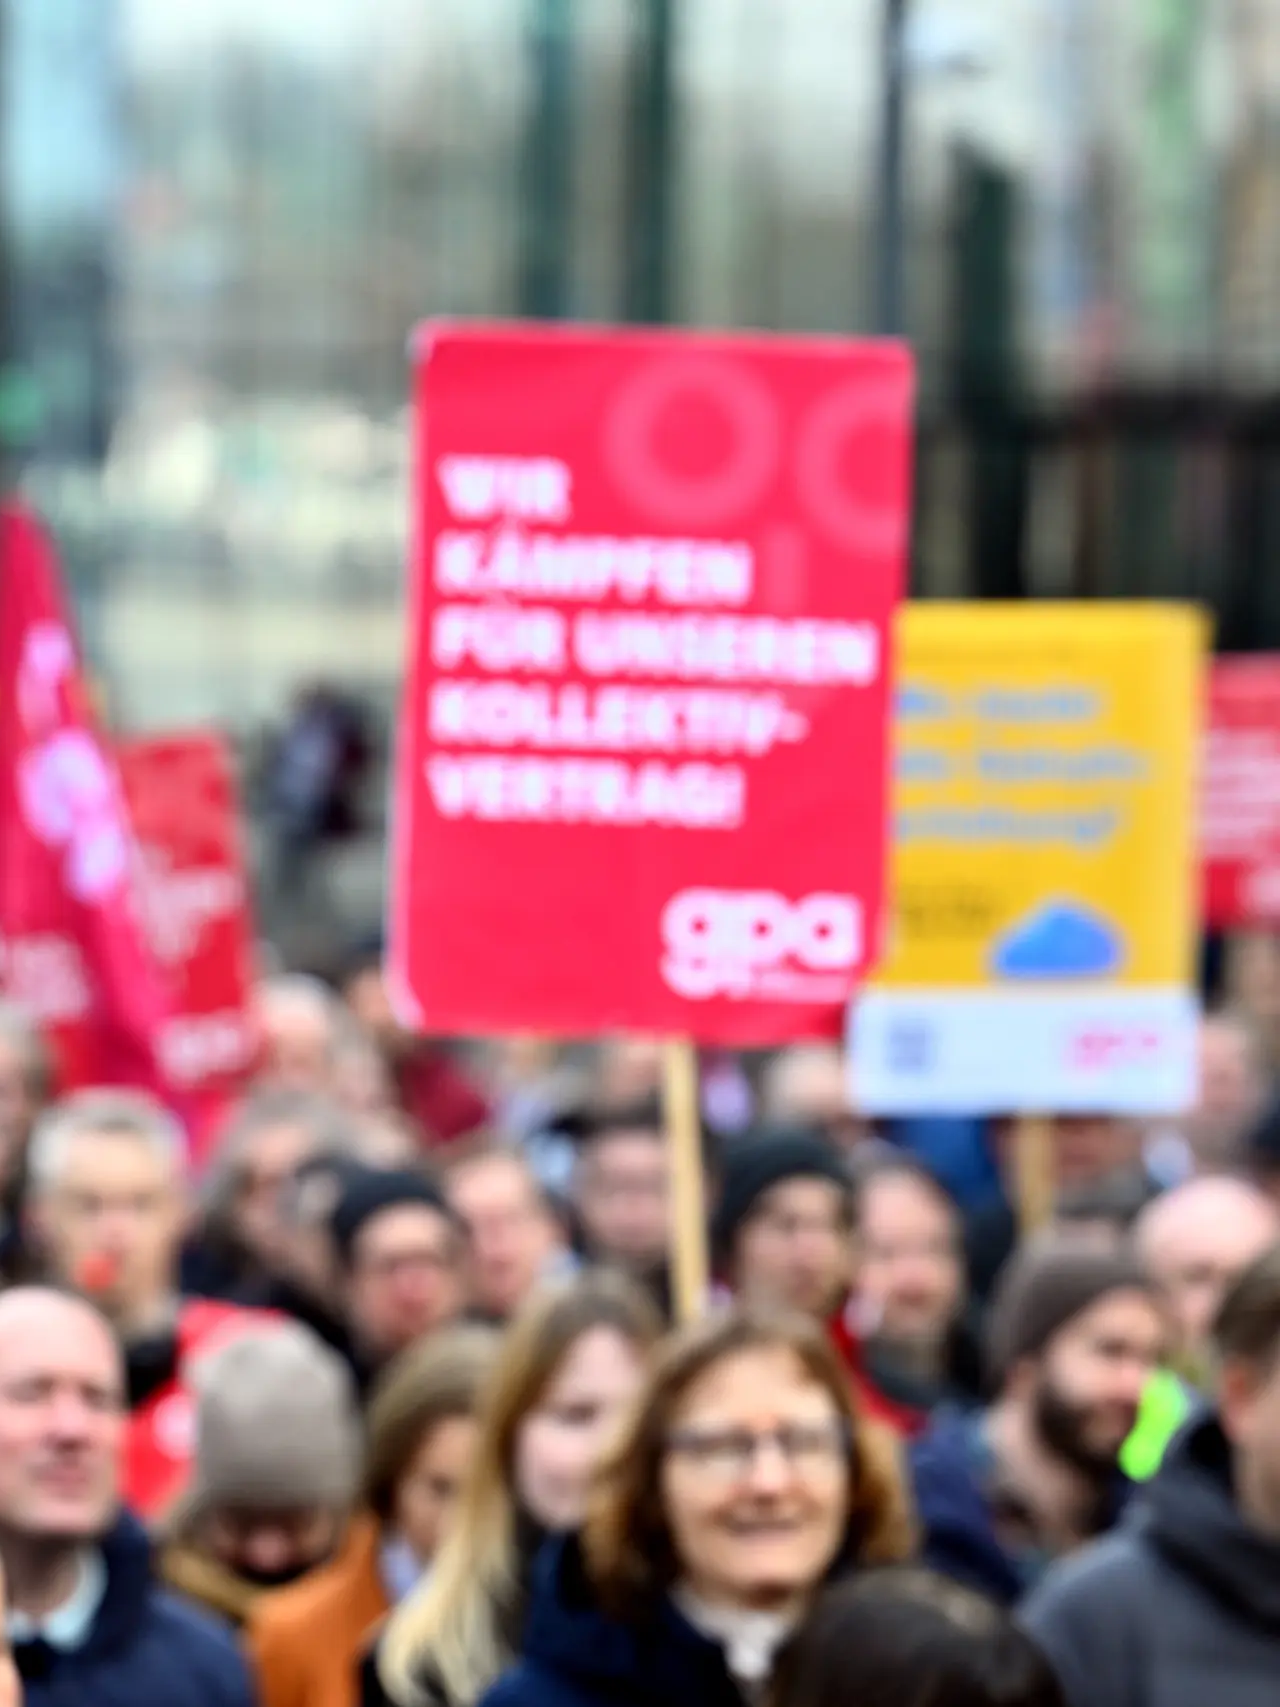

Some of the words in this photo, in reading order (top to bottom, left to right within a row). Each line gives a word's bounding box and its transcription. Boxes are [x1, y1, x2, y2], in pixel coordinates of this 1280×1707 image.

[438, 453, 572, 522] WIR
[433, 522, 754, 607] KÄMPFEN
[431, 596, 565, 673] FÜR
[574, 609, 878, 688] UNSEREN
[428, 678, 810, 757] KOLLEKTIV-
[659, 886, 865, 1001] gpa
